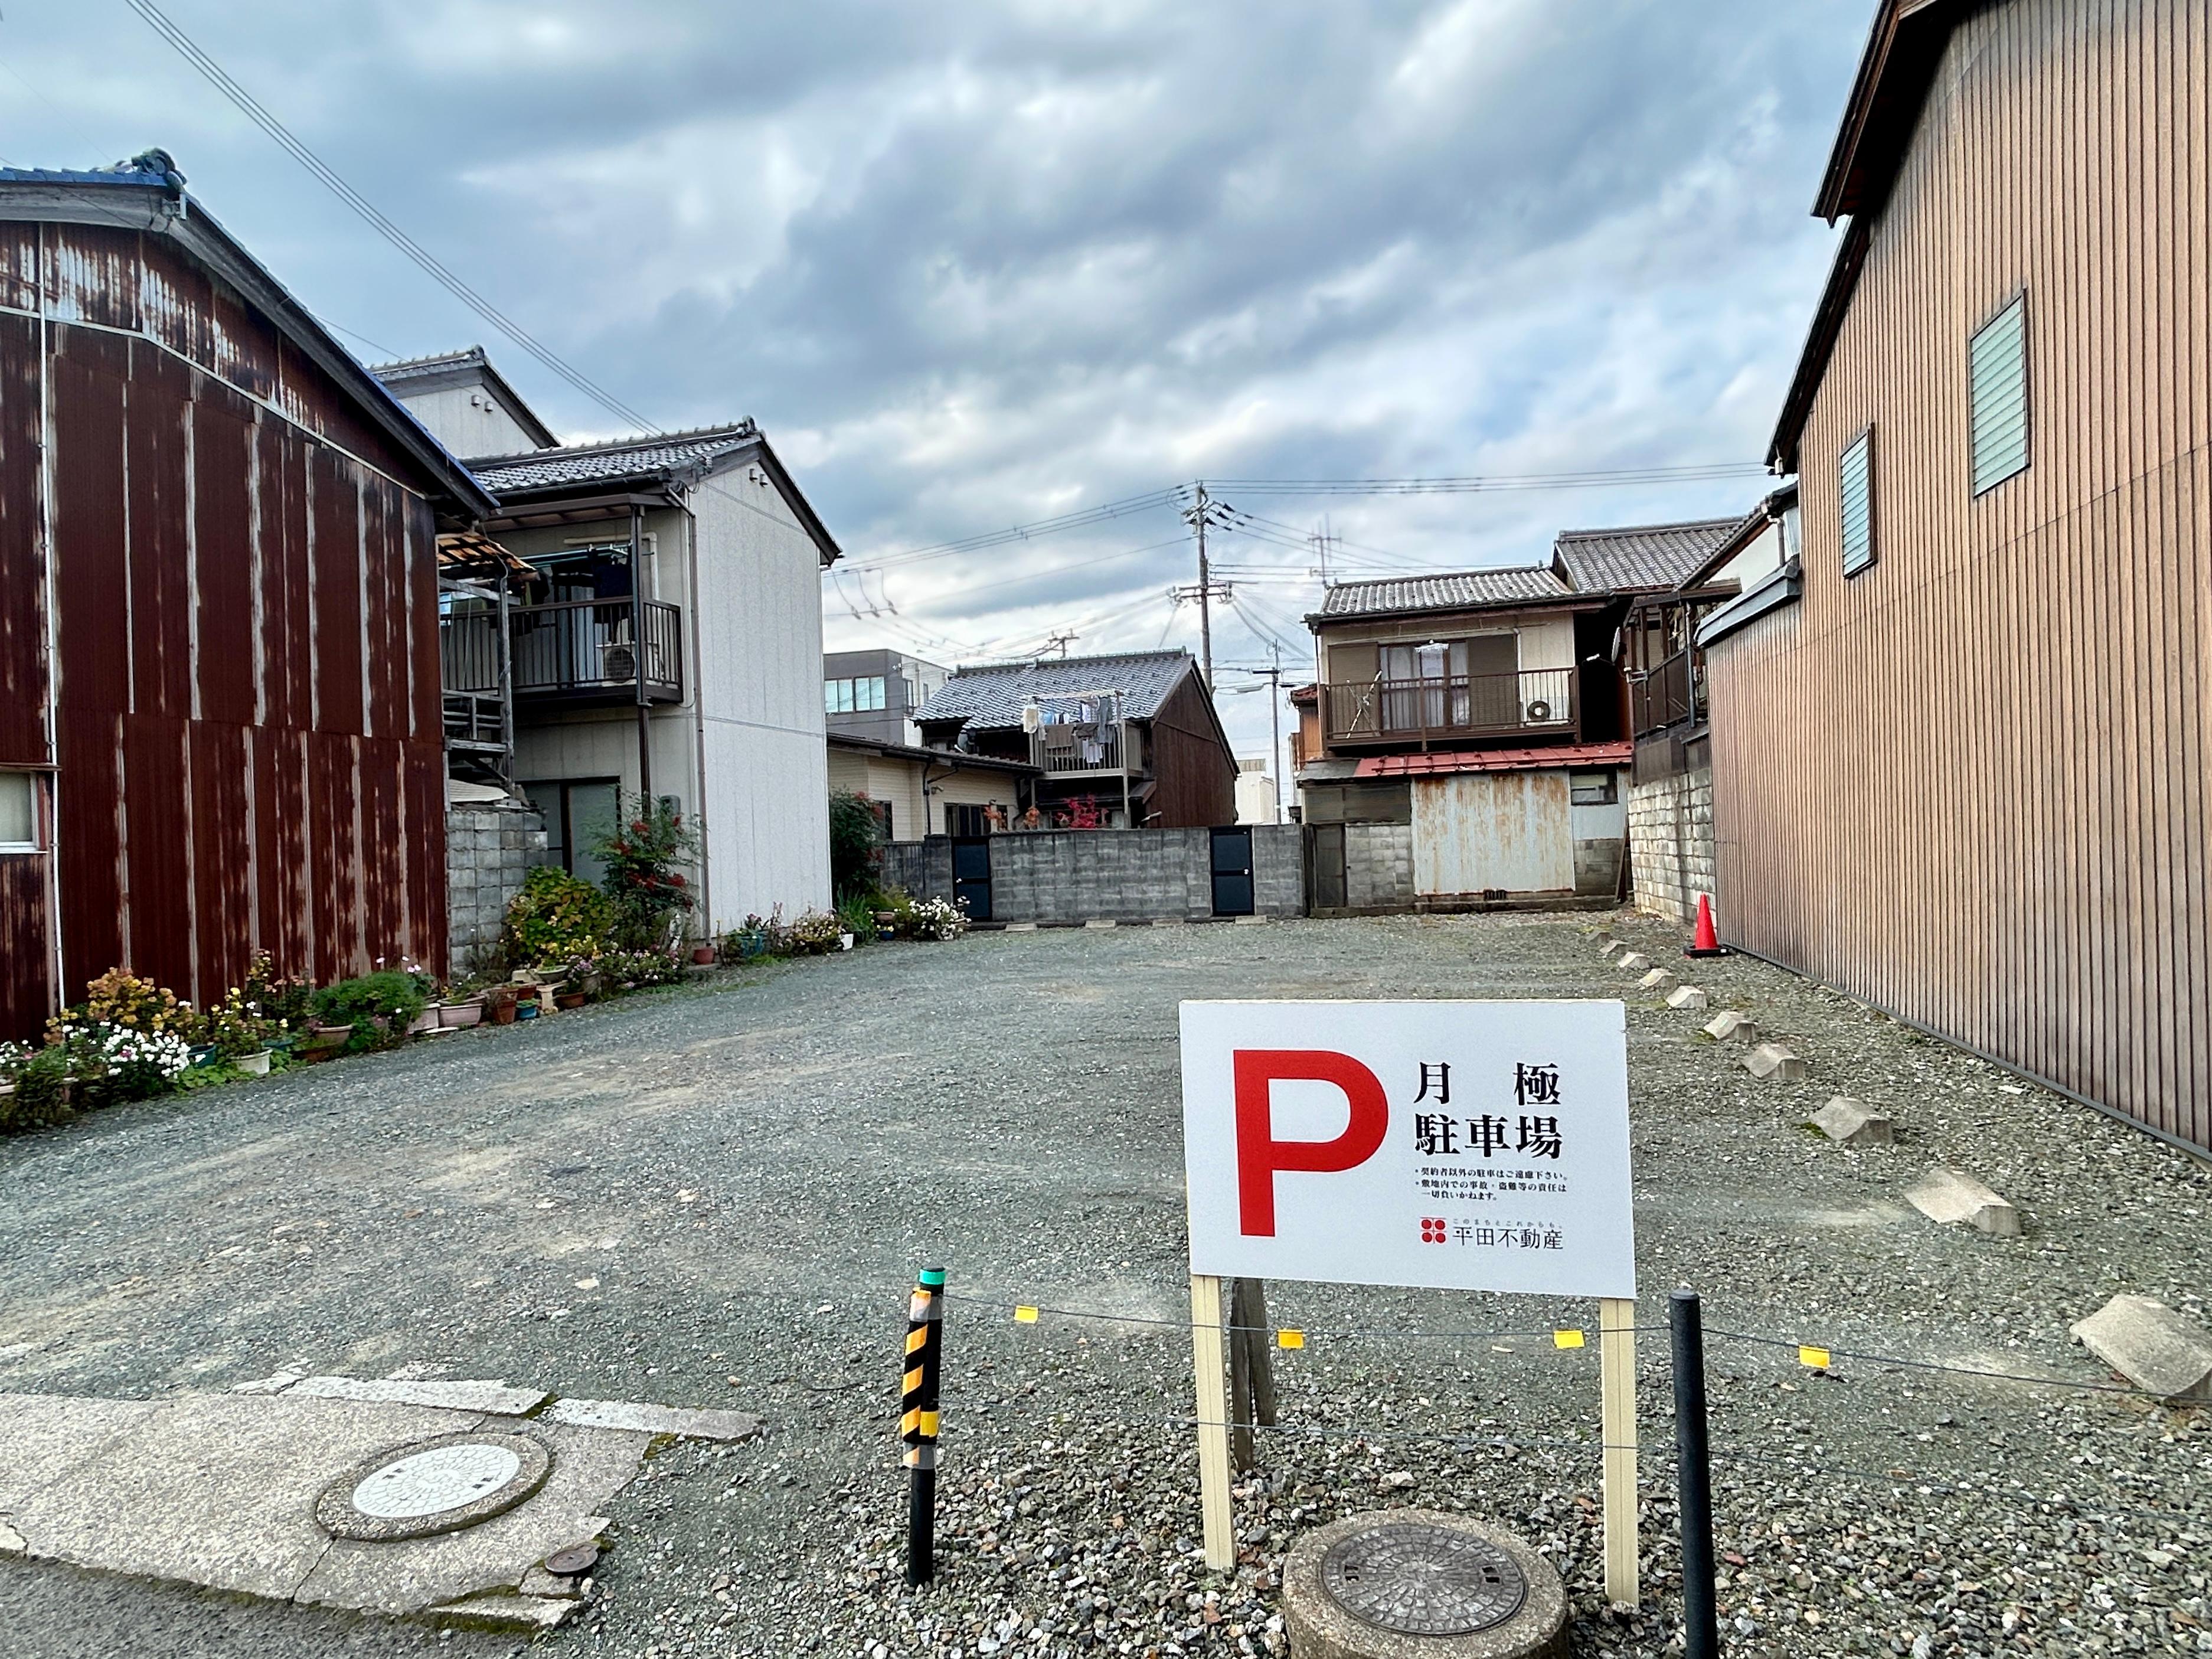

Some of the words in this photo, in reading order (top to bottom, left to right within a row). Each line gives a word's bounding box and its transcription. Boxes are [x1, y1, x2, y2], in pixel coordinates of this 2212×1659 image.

[1233, 1049, 1389, 1237] P
[1415, 1113, 1563, 1159] 駐車場
[1452, 1226, 1563, 1250] 平田不動産
